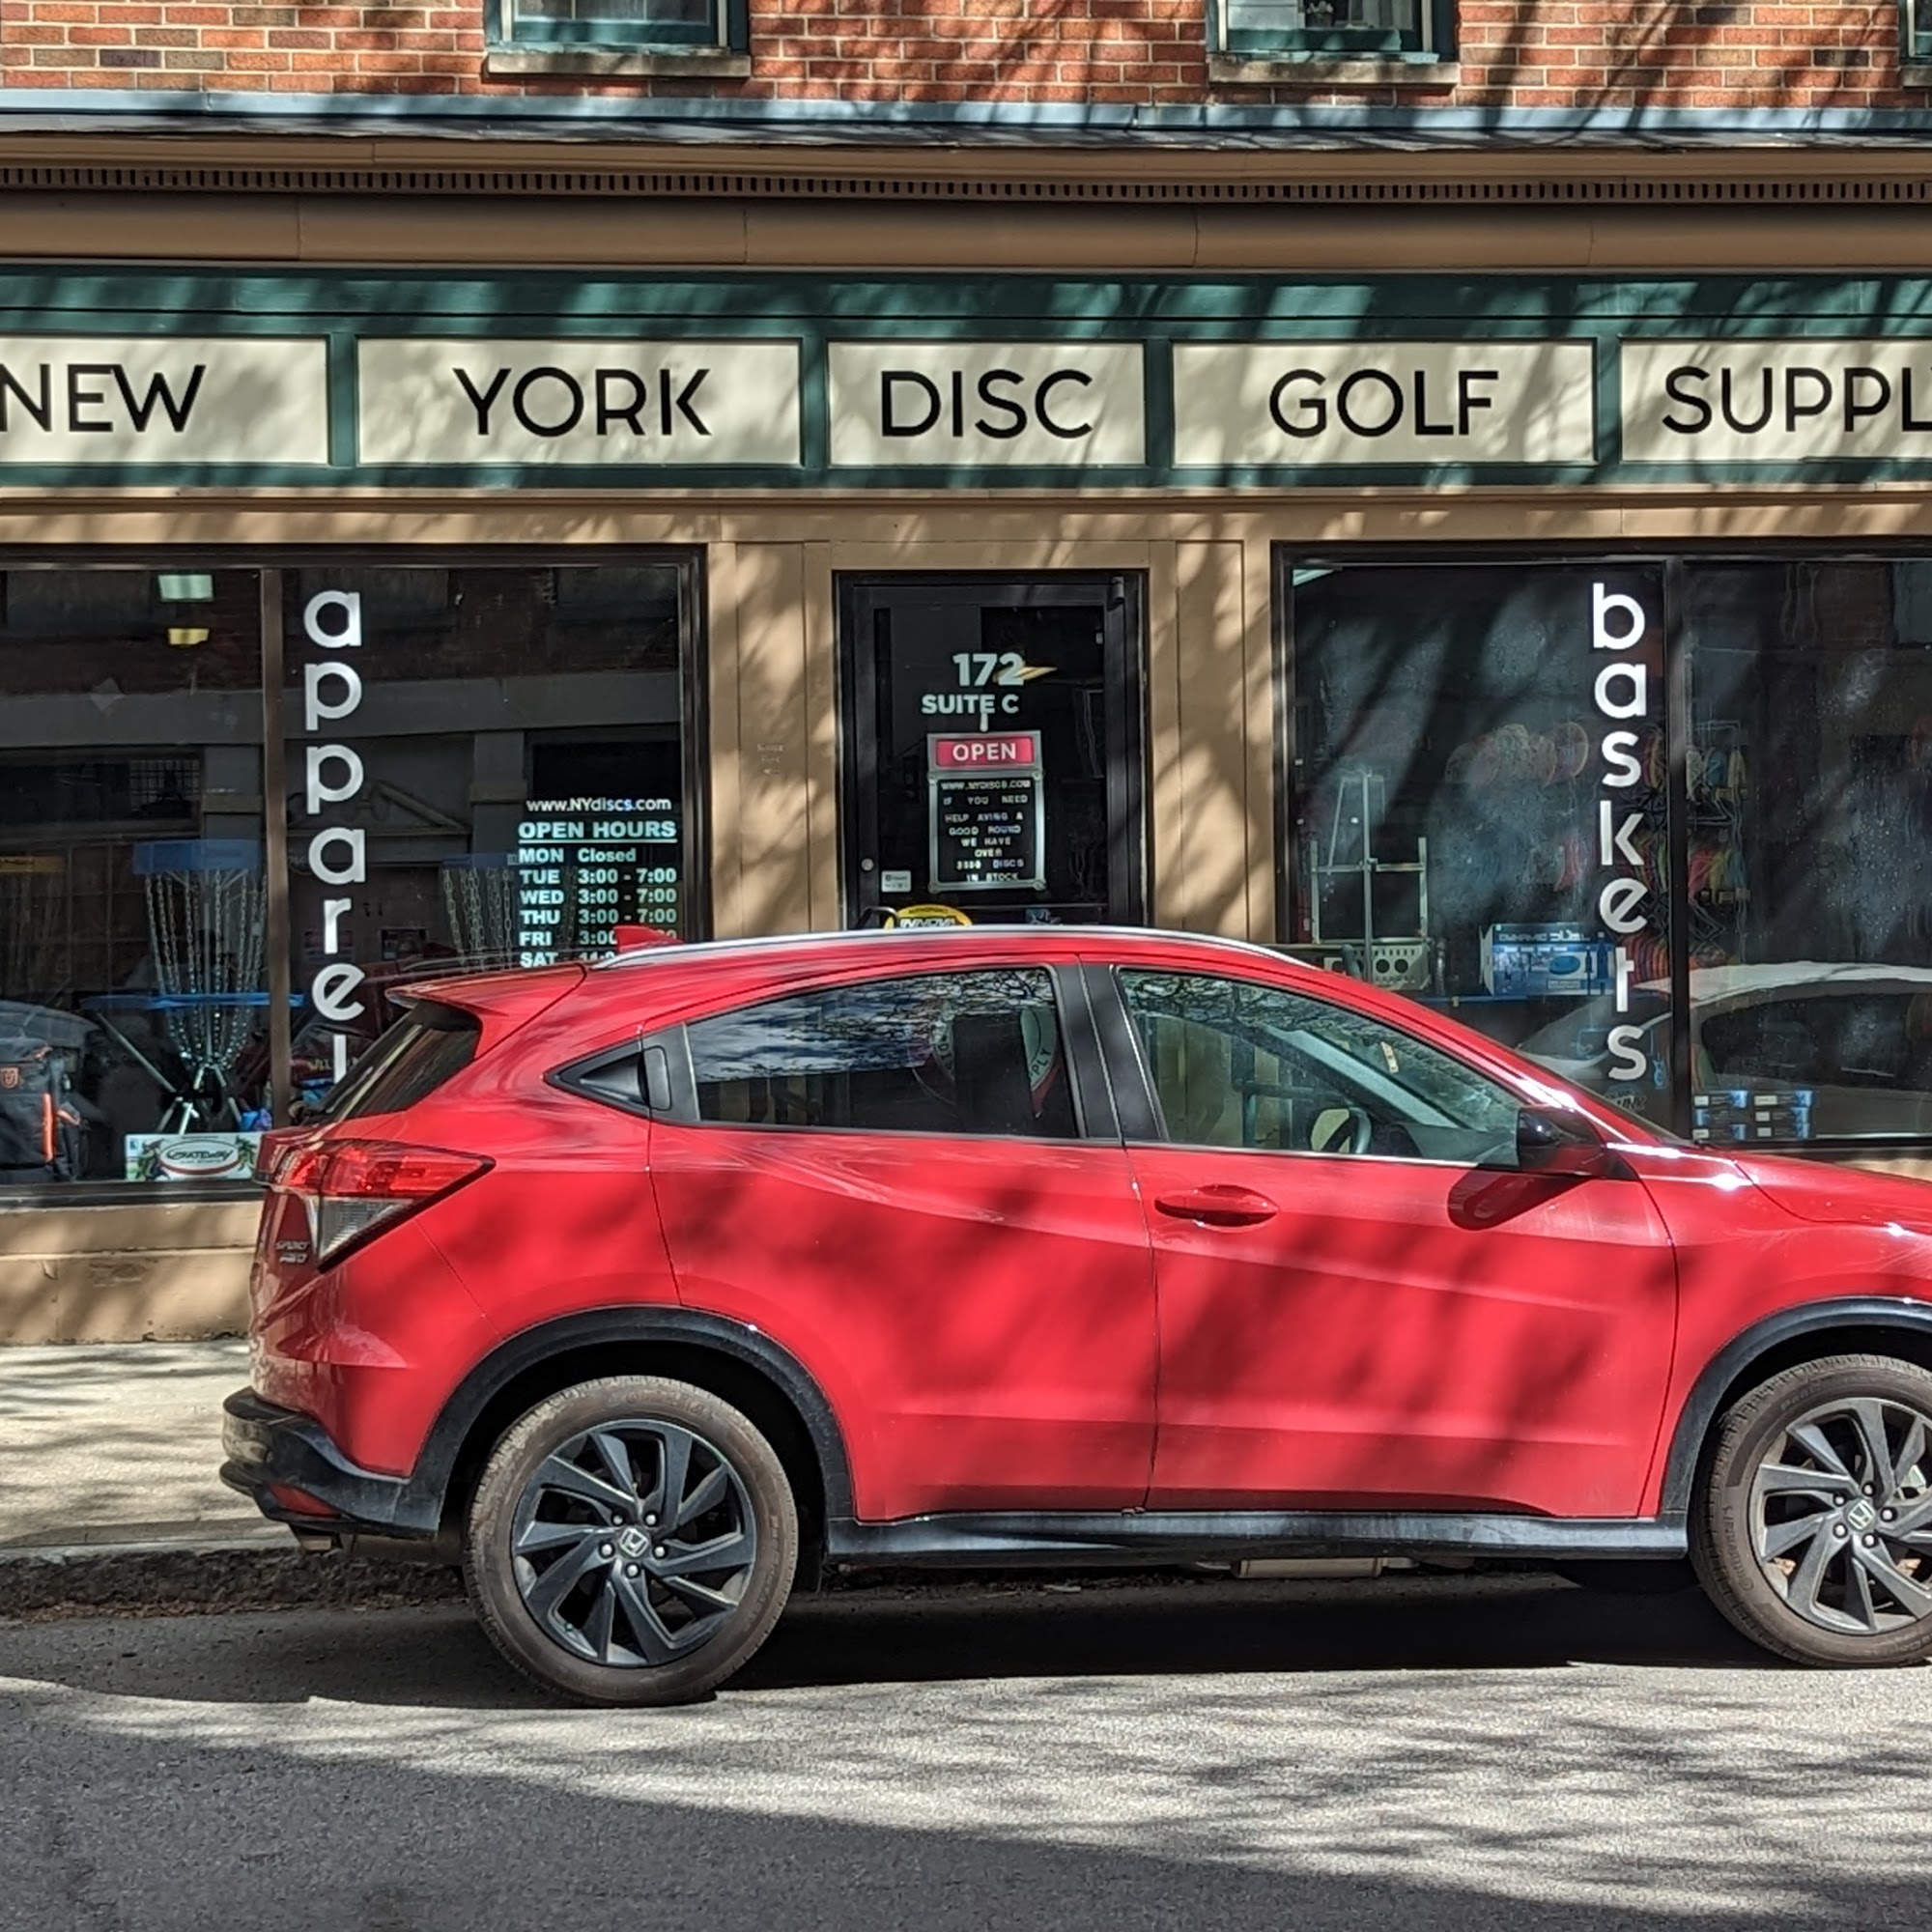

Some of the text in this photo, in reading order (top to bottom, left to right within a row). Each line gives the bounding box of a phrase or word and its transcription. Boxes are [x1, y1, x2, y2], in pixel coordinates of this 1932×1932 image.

[0, 363, 1932, 440] NEW YORK DISC GOLF SUPPL
[952, 652, 1025, 687] 172
[921, 694, 1020, 715] SUITE C
[952, 742, 1017, 763] OPEN
[526, 797, 672, 812] www.NYdiscs.com
[303, 590, 366, 1083] apparel
[518, 820, 677, 839] OPEN HOURS
[1592, 582, 1648, 1082] baskets
[518, 847, 637, 863] MON Closed
[519, 868, 561, 884] TUE
[578, 868, 618, 884] 3:00
[637, 867, 677, 883] 7:00
[520, 890, 564, 904] WED
[578, 889, 618, 904] 3:00
[637, 888, 677, 903] 7:00
[519, 910, 561, 924] THU
[578, 909, 618, 924] 3:00
[637, 908, 677, 923] 7:00
[519, 930, 553, 946] FRI
[520, 952, 558, 968] SAT
